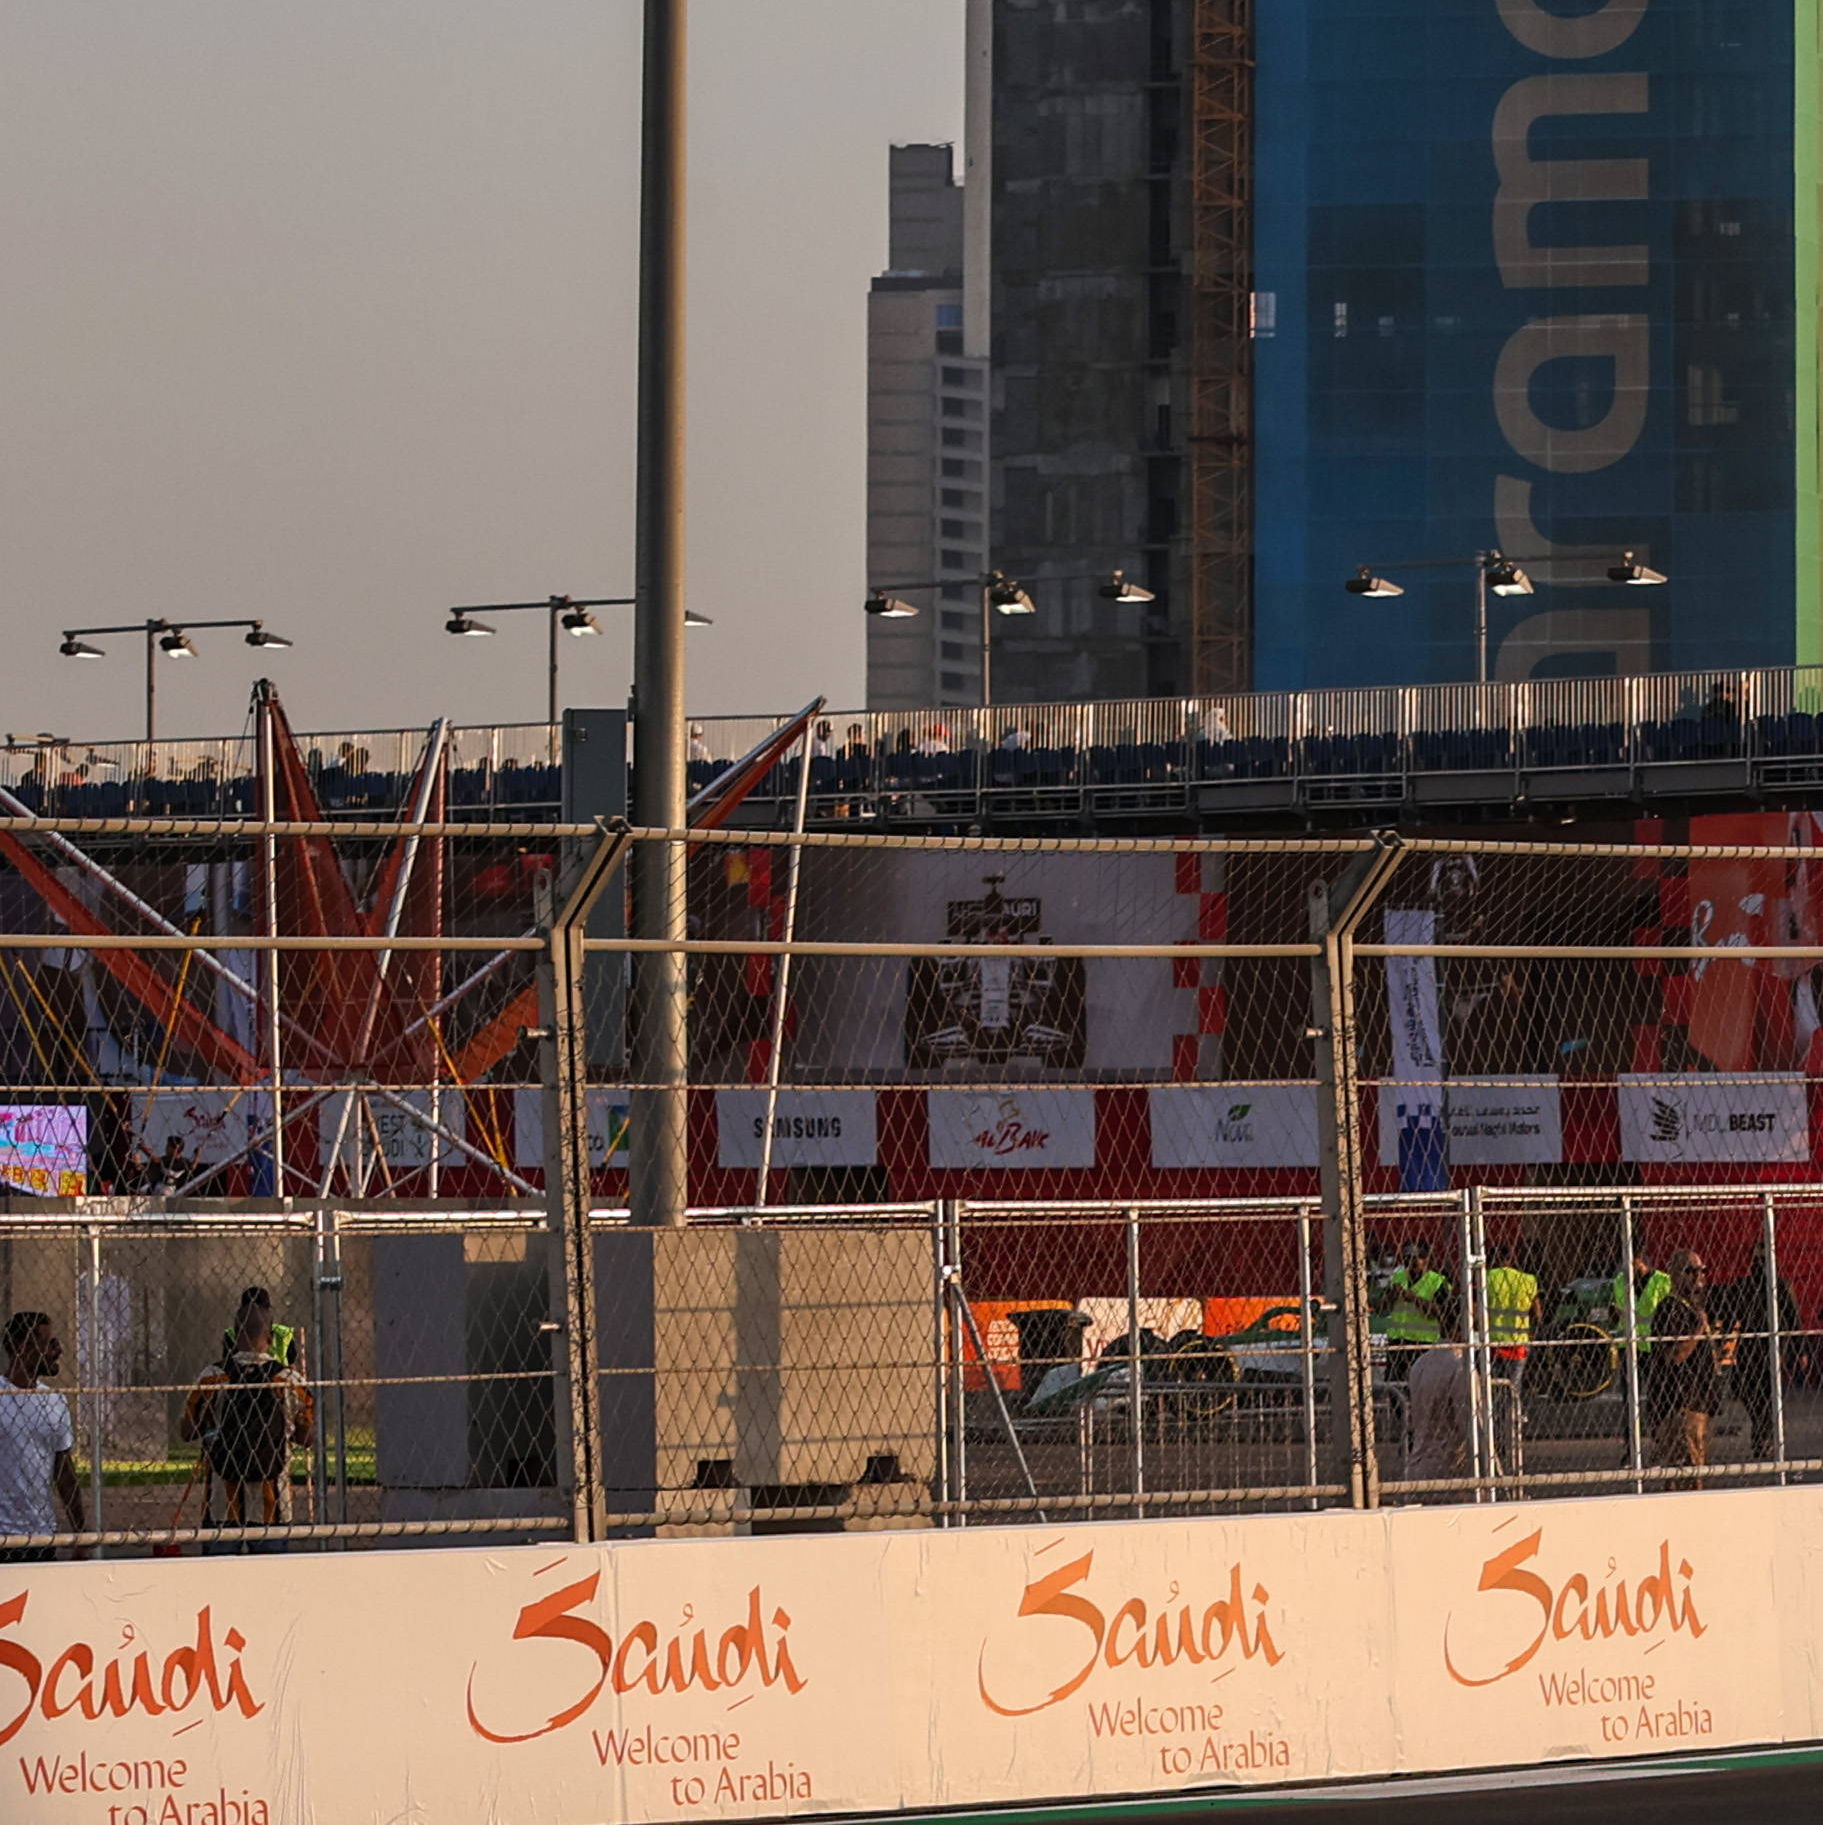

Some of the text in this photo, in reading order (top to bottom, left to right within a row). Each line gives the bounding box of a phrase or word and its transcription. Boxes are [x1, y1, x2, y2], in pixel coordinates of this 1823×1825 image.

[1444, 1526, 1709, 1688] Saudi
[978, 1548, 1285, 1717] Saudi
[467, 1568, 809, 1744] Saudi
[1538, 1669, 1656, 1708] Welcome
[1087, 1696, 1223, 1739] Welcome
[1600, 1701, 1713, 1742] to Arabia
[592, 1724, 741, 1767] Welcome
[1160, 1731, 1290, 1775] to Arabia
[19, 1750, 188, 1797] Welcome
[671, 1760, 813, 1806] to Arabia
